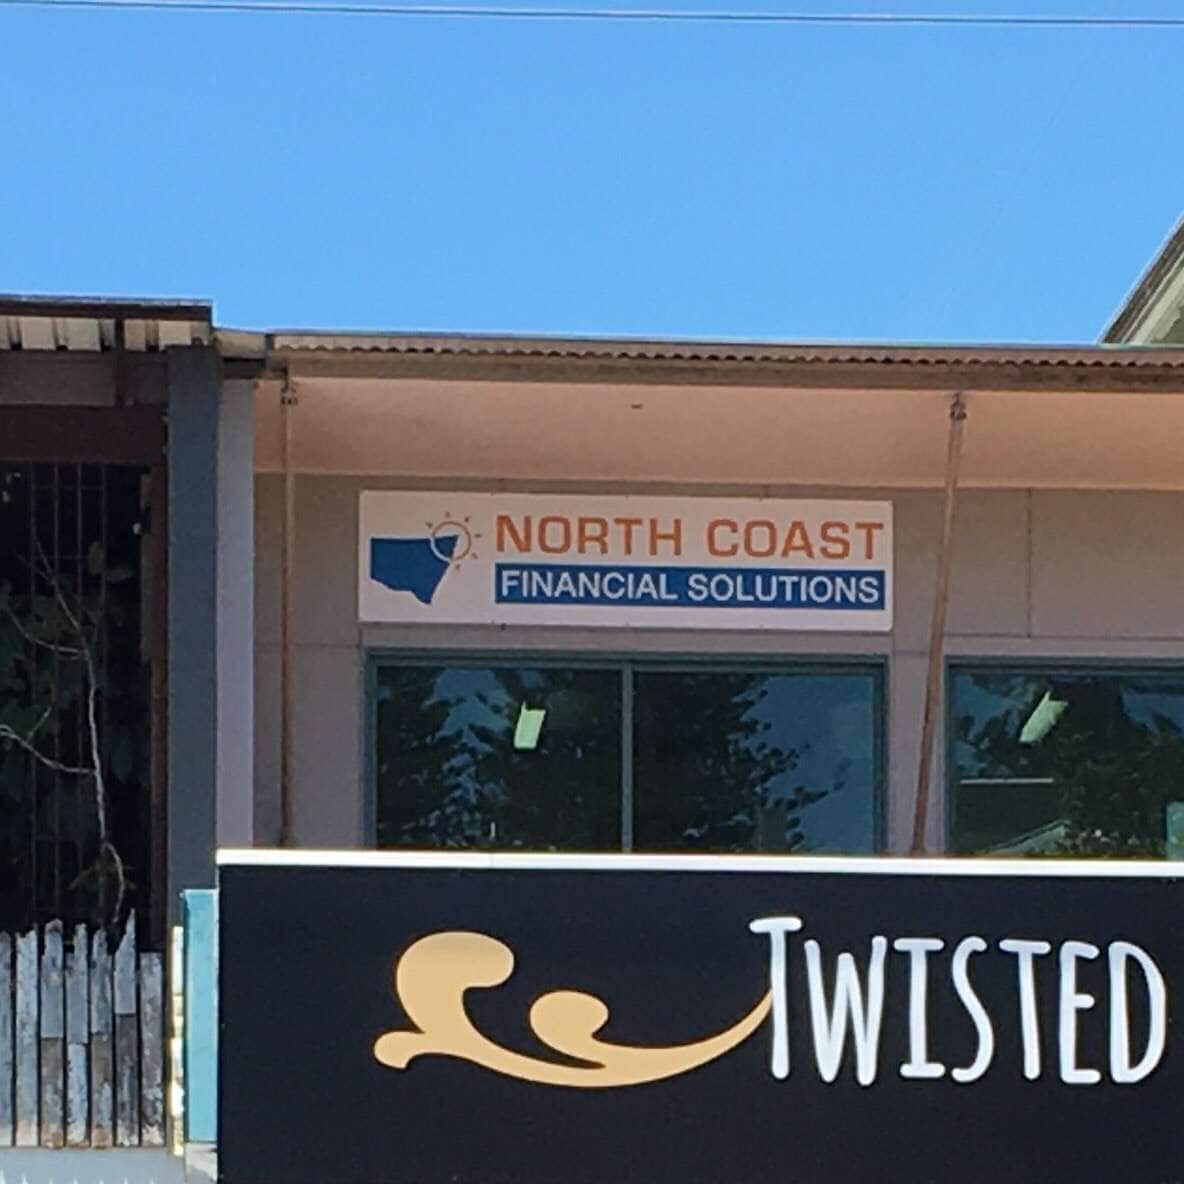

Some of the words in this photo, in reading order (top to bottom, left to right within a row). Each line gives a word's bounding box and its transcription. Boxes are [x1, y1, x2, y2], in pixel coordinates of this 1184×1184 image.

[495, 514, 683, 556] NORTH
[706, 517, 884, 561] COAST
[500, 569, 679, 601] FINANCIAL
[687, 572, 880, 604] SOLUTIONS
[748, 915, 1167, 1087] TWISTED
